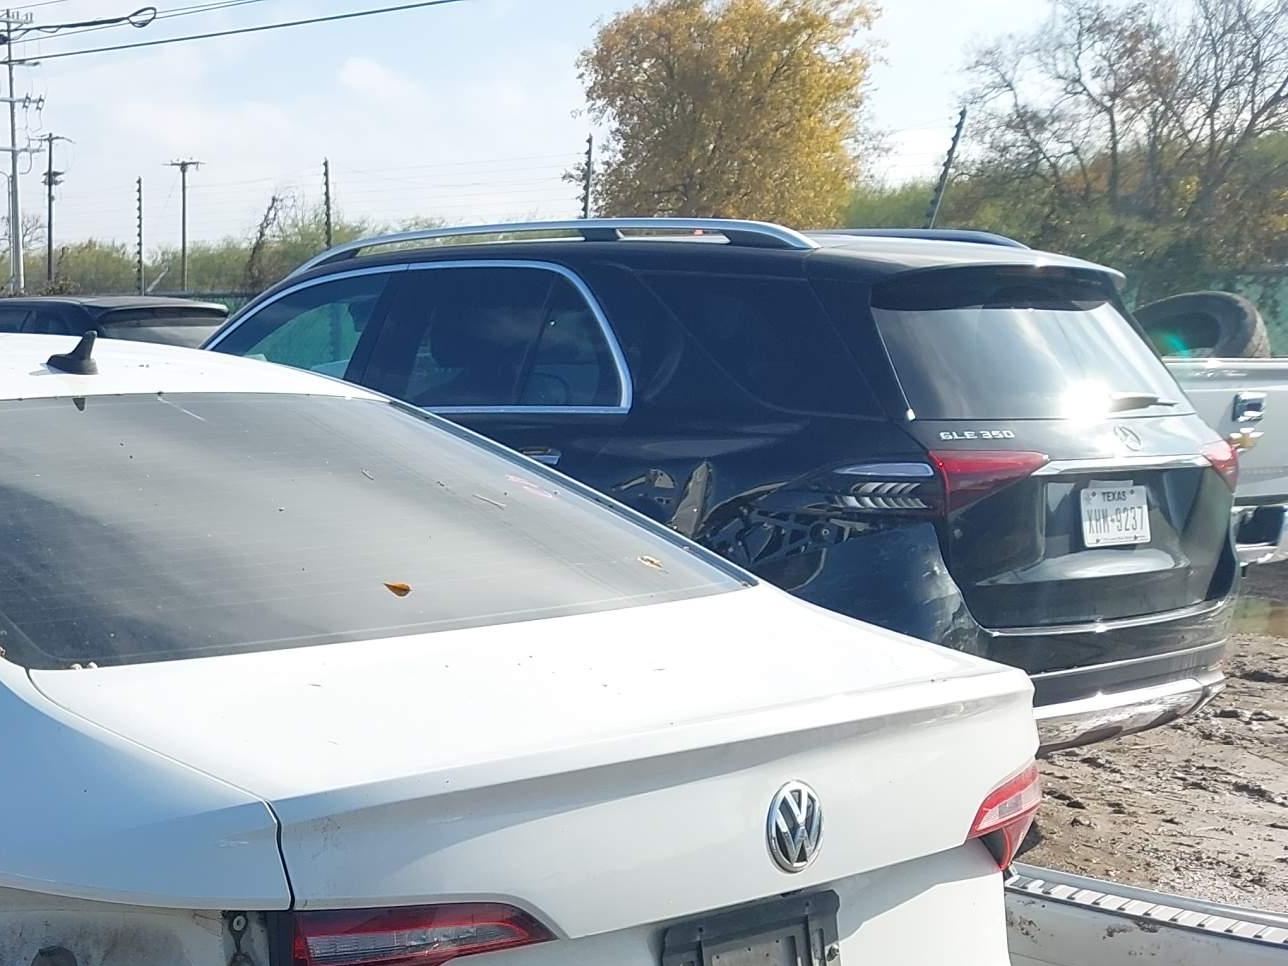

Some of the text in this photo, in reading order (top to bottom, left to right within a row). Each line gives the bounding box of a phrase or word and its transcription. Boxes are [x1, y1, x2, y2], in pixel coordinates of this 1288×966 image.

[939, 430, 1016, 440] GLE 350
[1101, 490, 1127, 502] TEXAS
